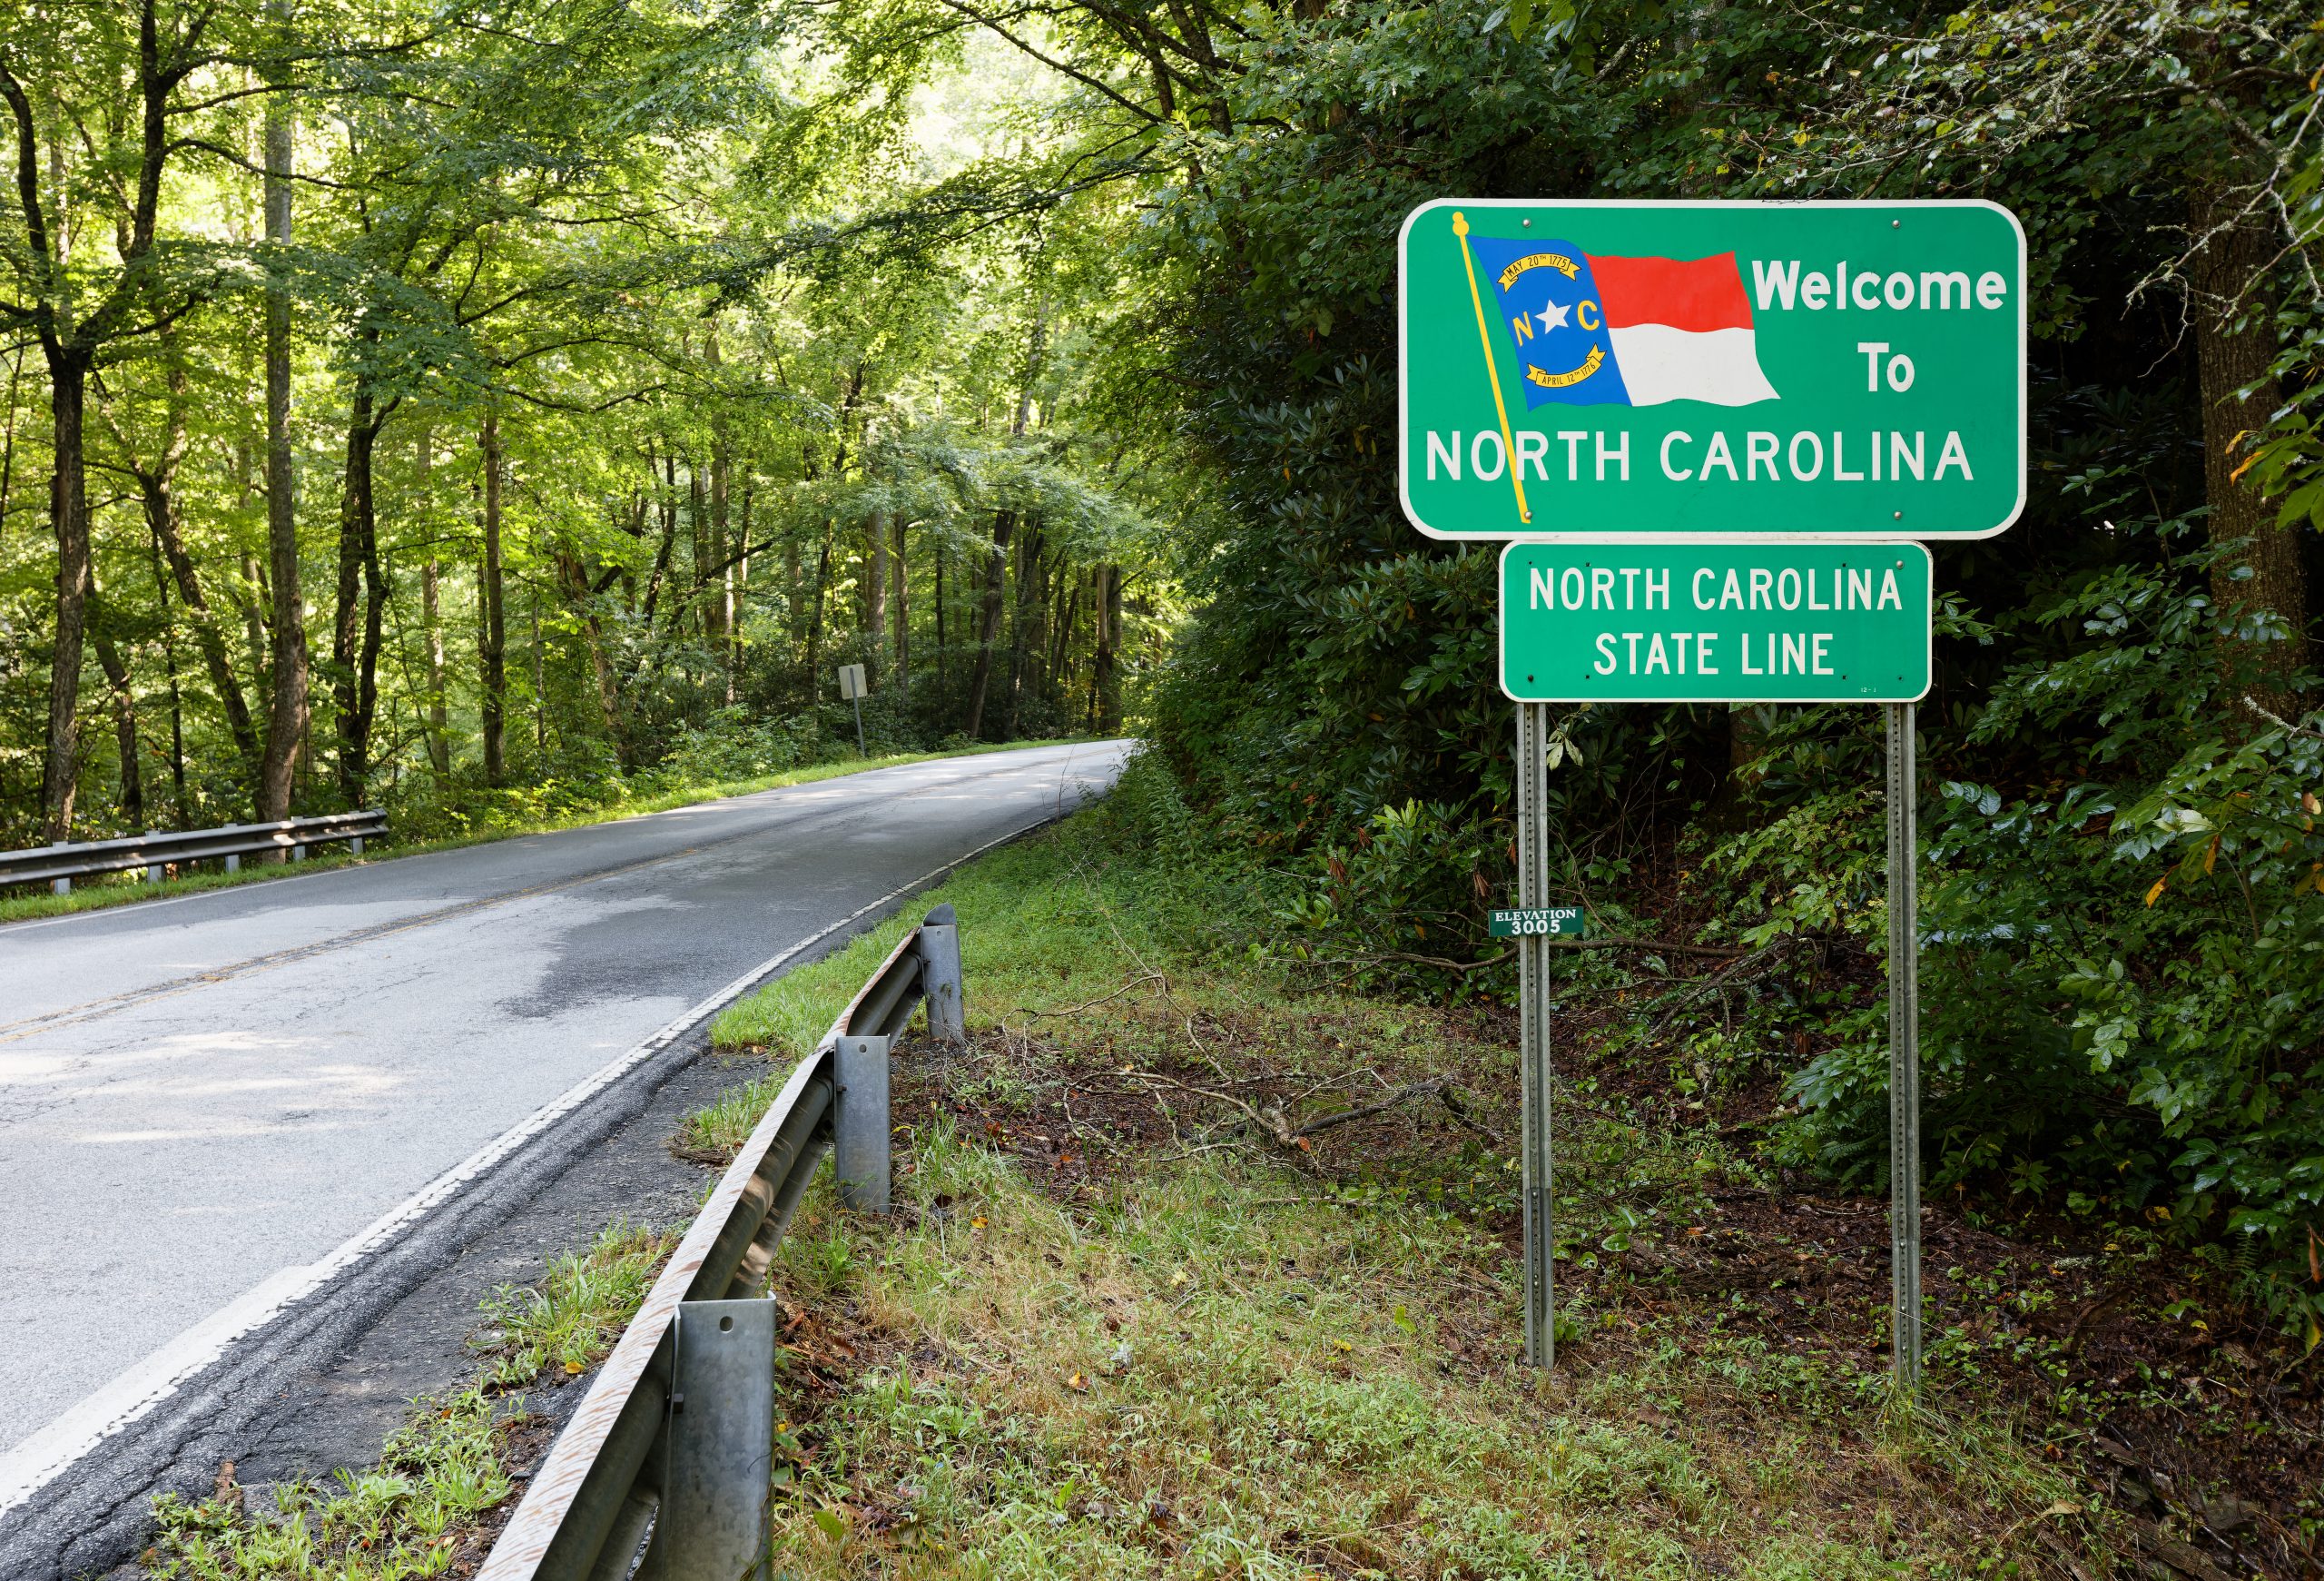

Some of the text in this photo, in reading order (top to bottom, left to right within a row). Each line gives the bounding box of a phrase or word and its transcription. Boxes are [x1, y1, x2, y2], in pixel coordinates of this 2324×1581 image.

[1506, 262, 1523, 277] MAY
[1549, 255, 1568, 268] 1775
[1752, 260, 2007, 311] Welcome
[1512, 300, 1600, 347] N C
[1541, 375, 1563, 386] APRIL
[1581, 361, 1596, 377] 1776
[1857, 341, 1915, 393] To
[1426, 430, 1974, 482] NORTH CAROLINA
[1530, 567, 1903, 611] NORTH CAROLINA
[1593, 632, 1834, 676] STATE LINE
[1495, 909, 1577, 922] ELEVATION
[1512, 919, 1561, 935] 3005
